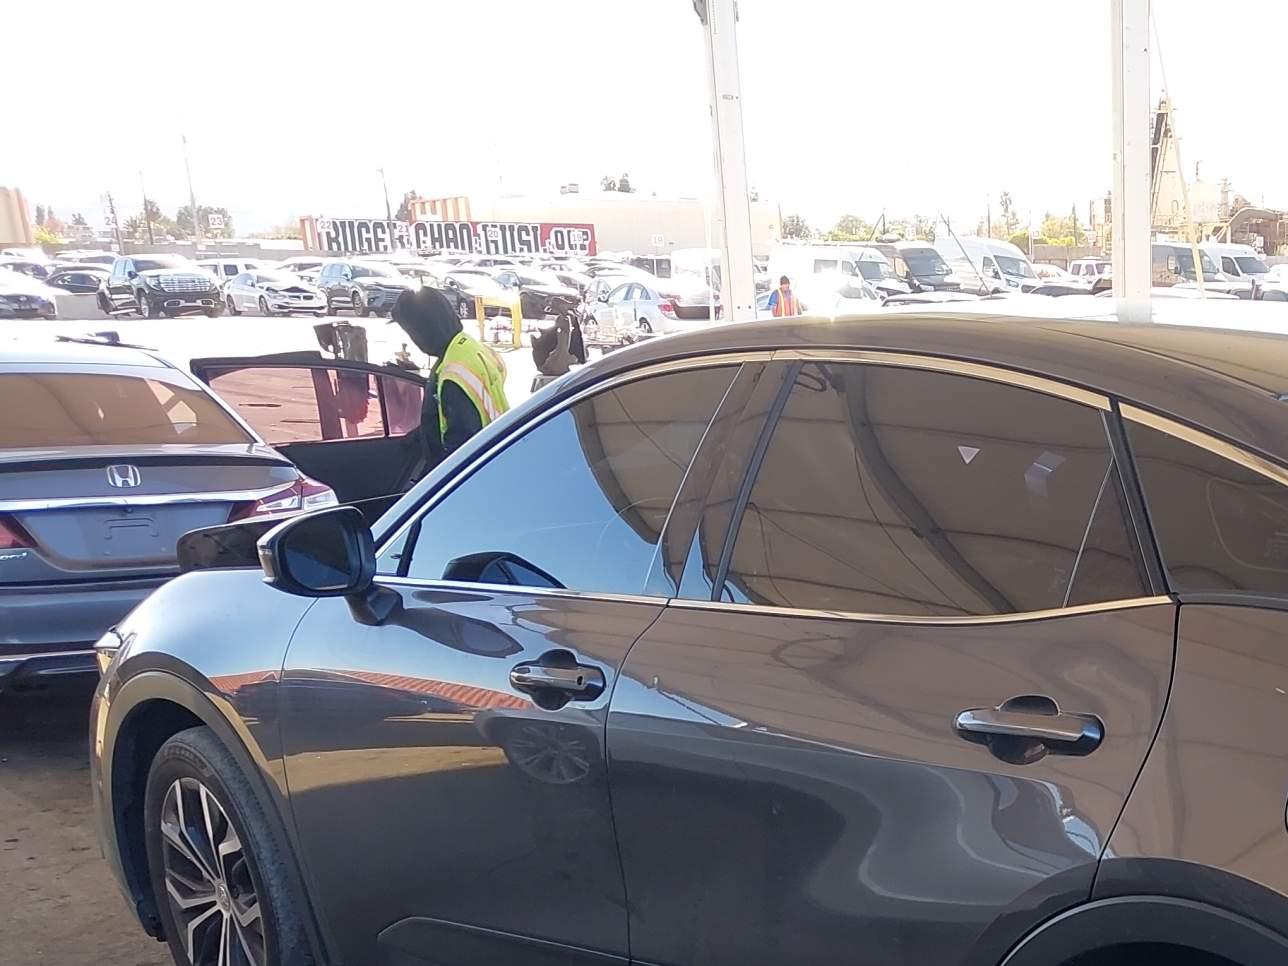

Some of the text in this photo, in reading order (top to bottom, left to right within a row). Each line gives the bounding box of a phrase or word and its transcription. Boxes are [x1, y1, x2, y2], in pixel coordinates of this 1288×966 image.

[210, 217, 224, 226] 23
[319, 220, 332, 230] 22
[488, 229, 499, 239] 20
